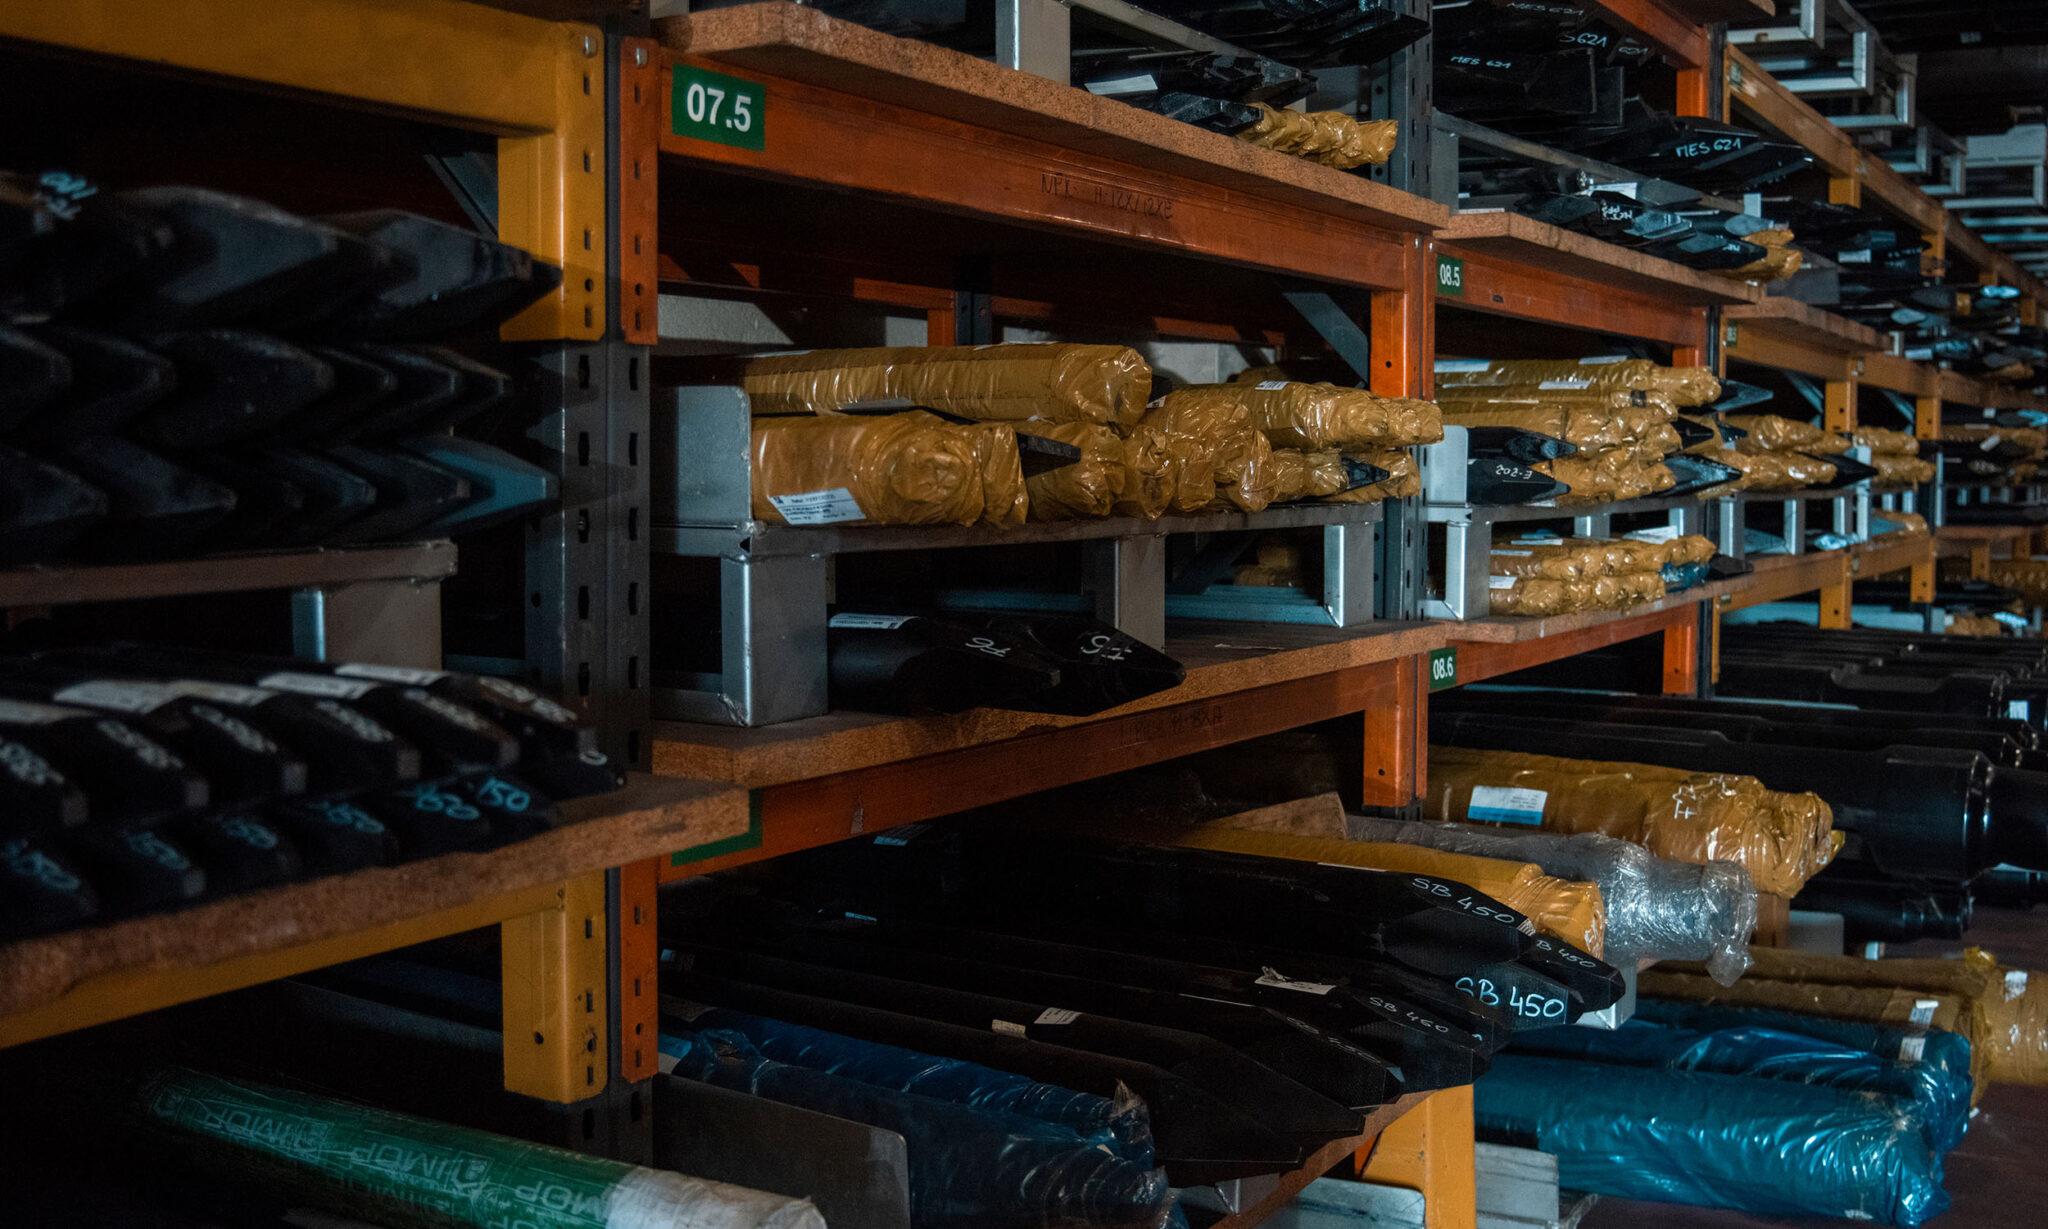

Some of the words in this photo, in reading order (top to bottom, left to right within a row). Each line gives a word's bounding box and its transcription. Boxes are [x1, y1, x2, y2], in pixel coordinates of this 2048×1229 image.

[1450, 55, 1481, 65] MES
[686, 83, 752, 133] 07.5
[1675, 141, 1711, 159] MES
[1713, 137, 1743, 152] 621
[1439, 263, 1461, 287] 08.5
[1432, 655, 1454, 681] 08.6
[1411, 876, 1452, 898] SB
[1456, 896, 1515, 924] 450
[1557, 947, 1597, 968] 450
[1368, 995, 1398, 1013] SB
[1508, 985, 1566, 1018] 450
